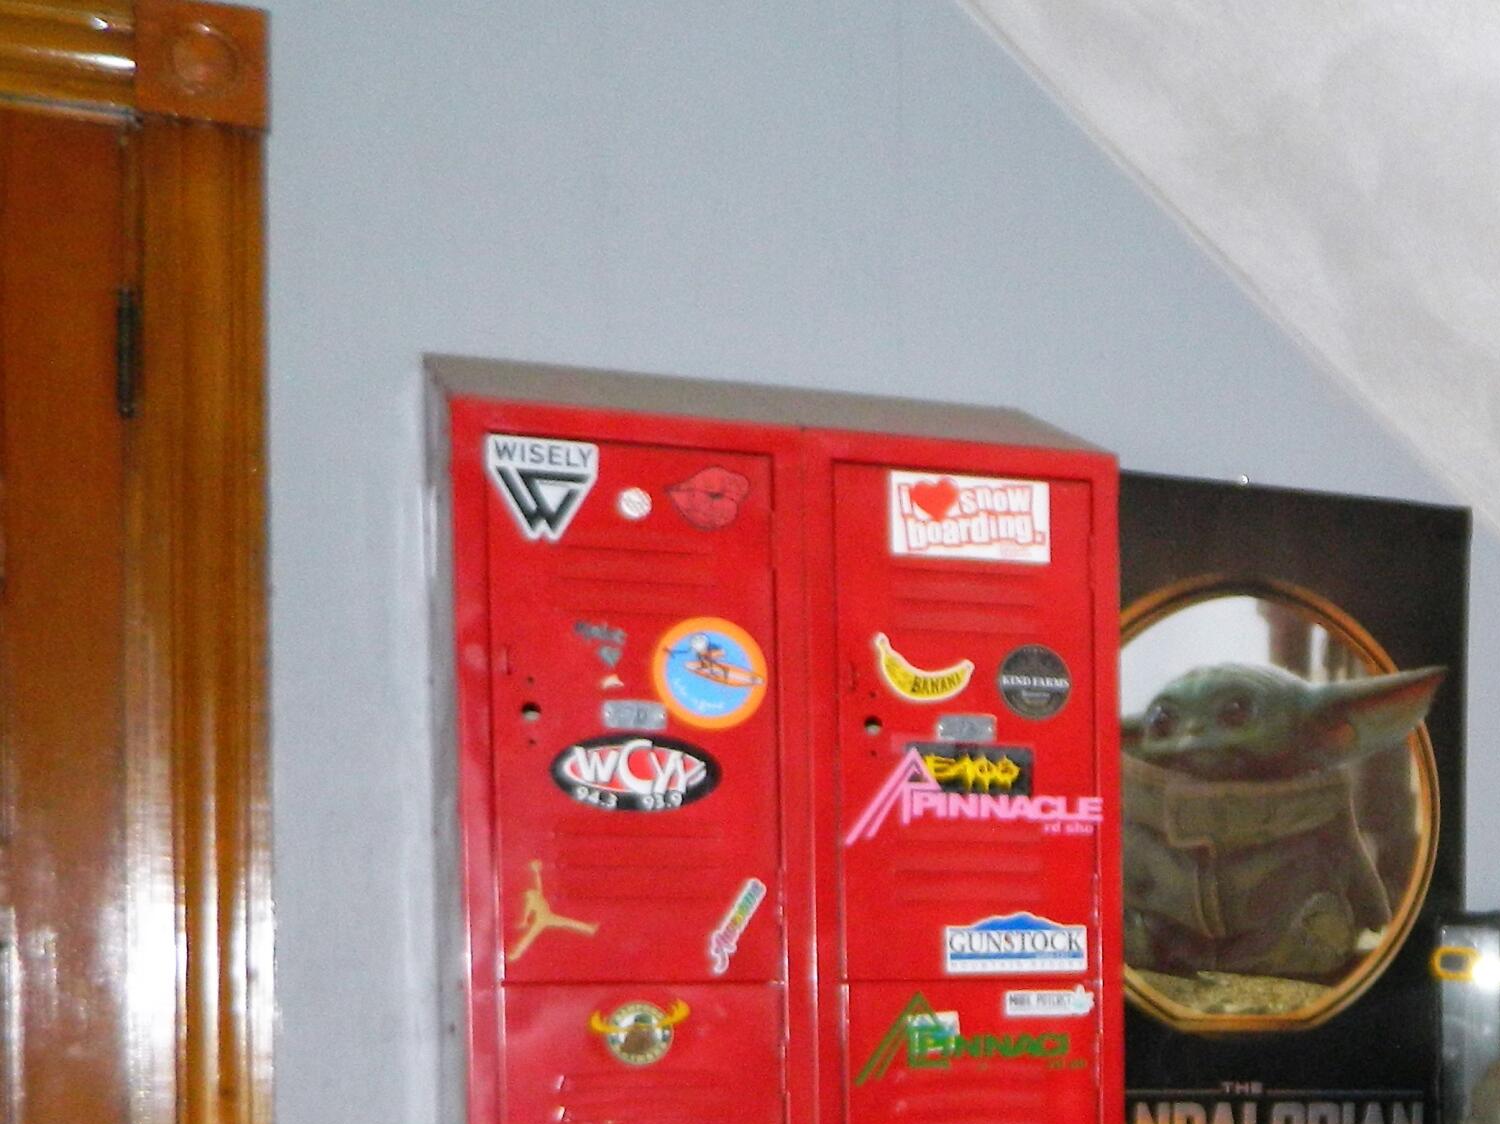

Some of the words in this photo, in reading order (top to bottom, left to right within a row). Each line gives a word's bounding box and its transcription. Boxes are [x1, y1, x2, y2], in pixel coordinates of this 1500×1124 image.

[493, 439, 592, 468] WISELY
[1002, 675, 1032, 687] KIND
[1033, 676, 1070, 688] FARMS
[911, 792, 1104, 821] PINNACLE
[949, 929, 1081, 952] GUNSTOCK
[1221, 1081, 1264, 1095] THE
